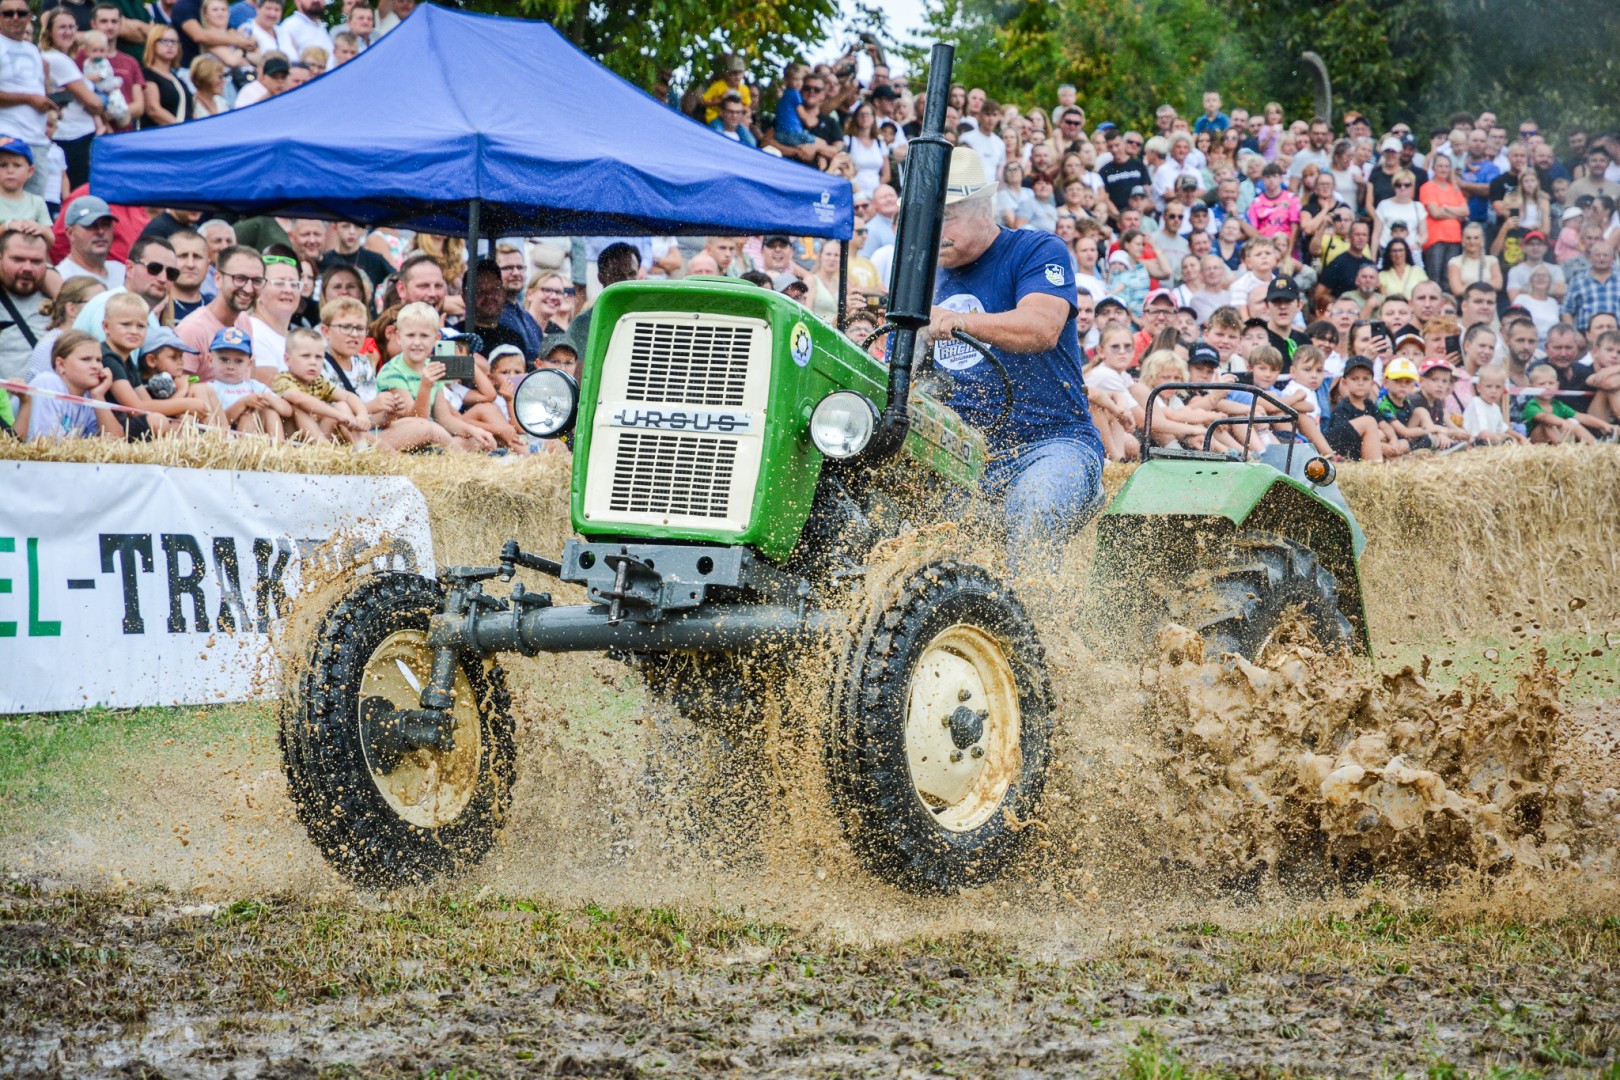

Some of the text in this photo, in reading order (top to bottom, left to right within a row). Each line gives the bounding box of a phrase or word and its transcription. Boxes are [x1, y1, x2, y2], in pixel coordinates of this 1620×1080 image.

[940, 344, 978, 360] RACI
[615, 409, 748, 431] URSUS
[0, 534, 417, 637] EL-TRAK
